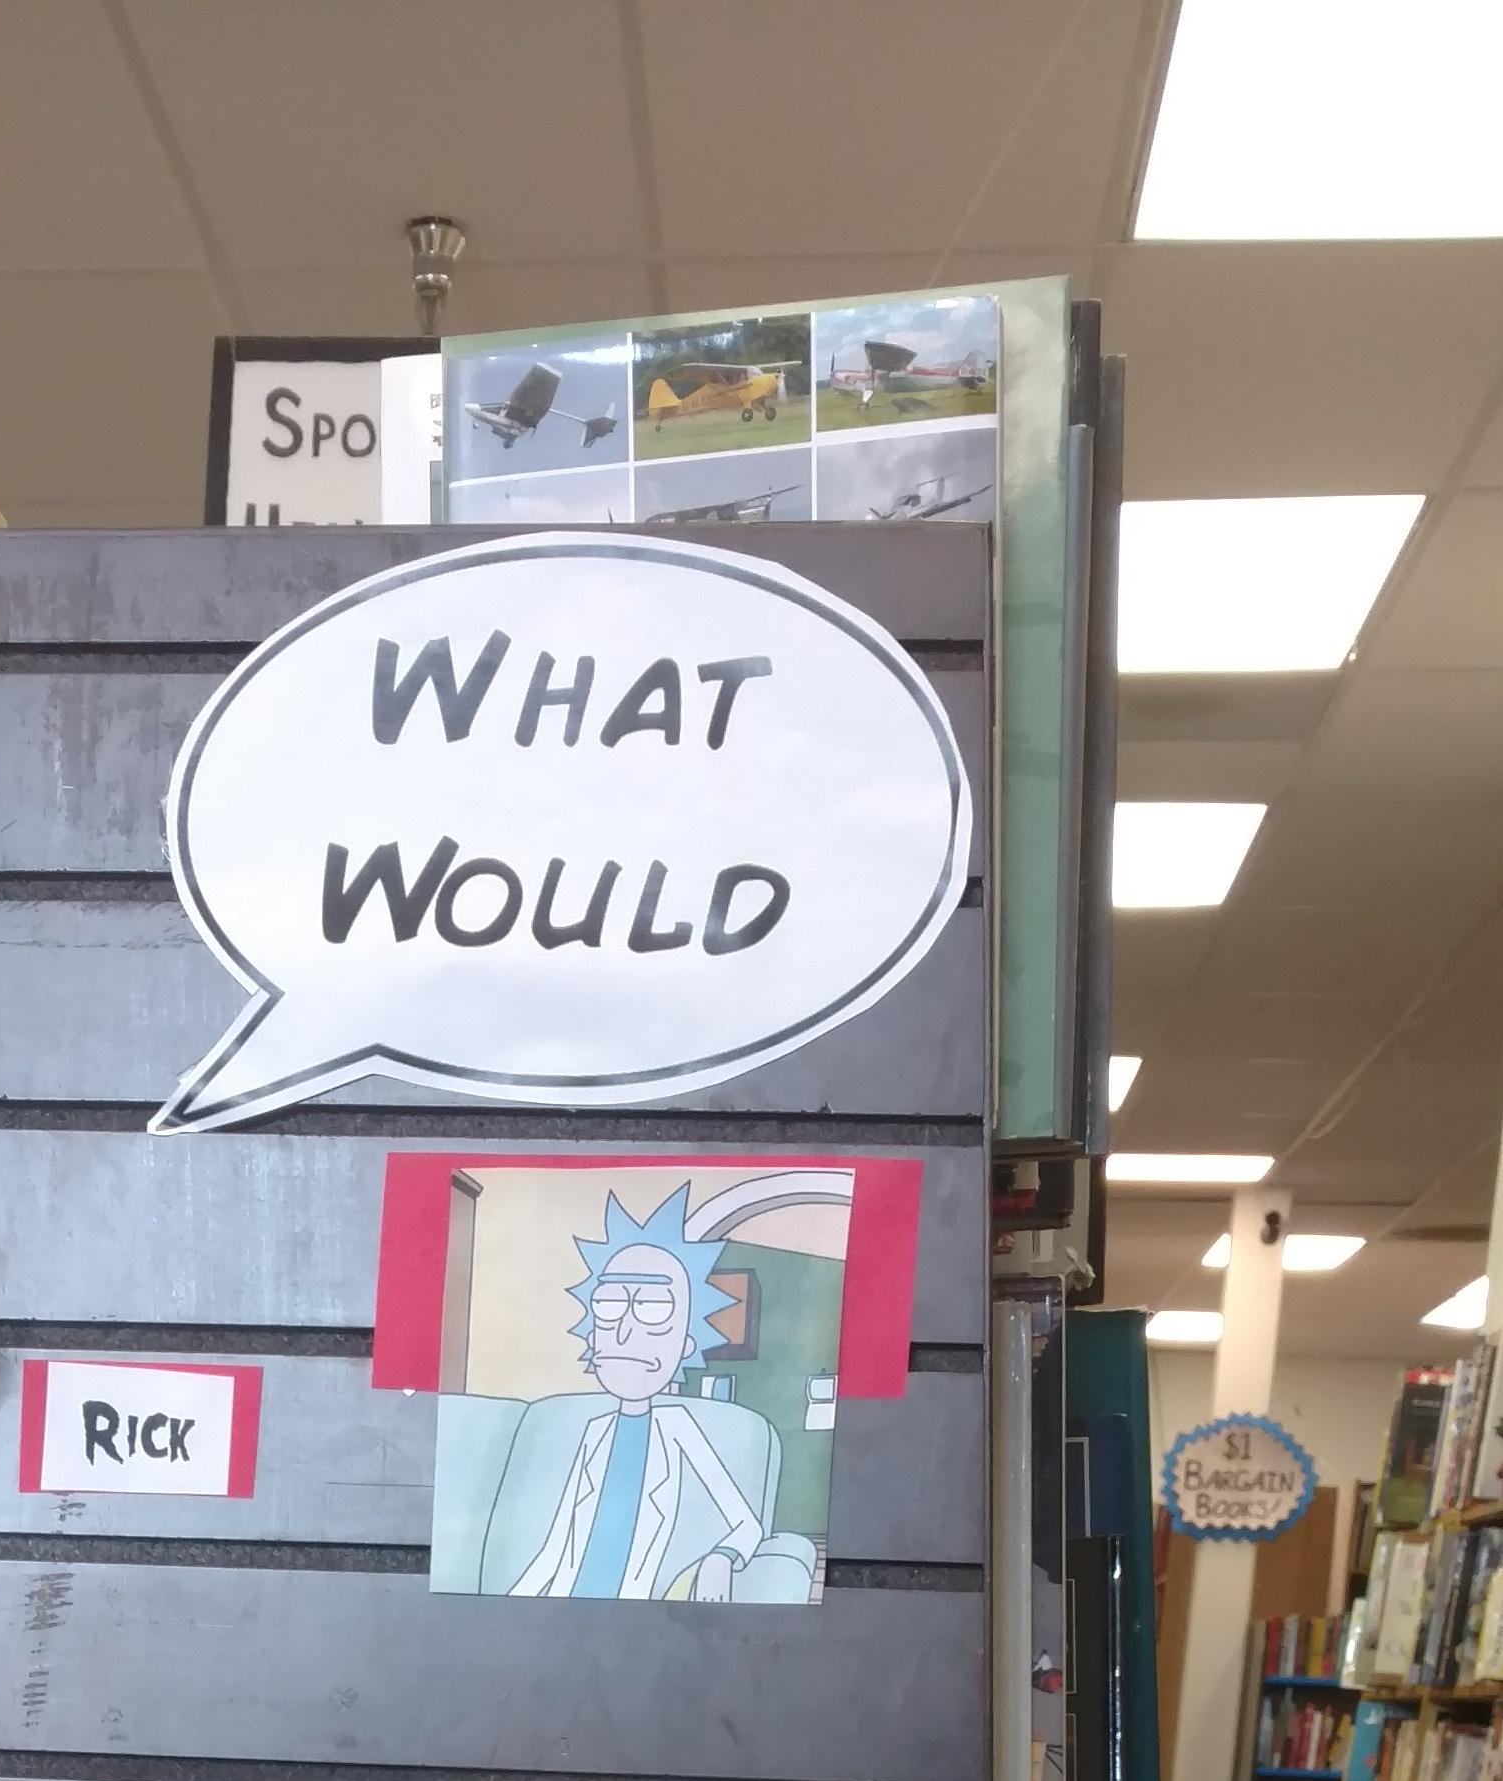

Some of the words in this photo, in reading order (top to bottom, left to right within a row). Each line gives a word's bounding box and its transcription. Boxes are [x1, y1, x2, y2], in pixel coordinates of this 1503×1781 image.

[372, 629, 773, 751] WHAT
[321, 836, 791, 956] WOULD
[82, 1400, 192, 1466] RICK
[1223, 1431, 1251, 1461] $1
[1183, 1460, 1295, 1494] BARGAIN
